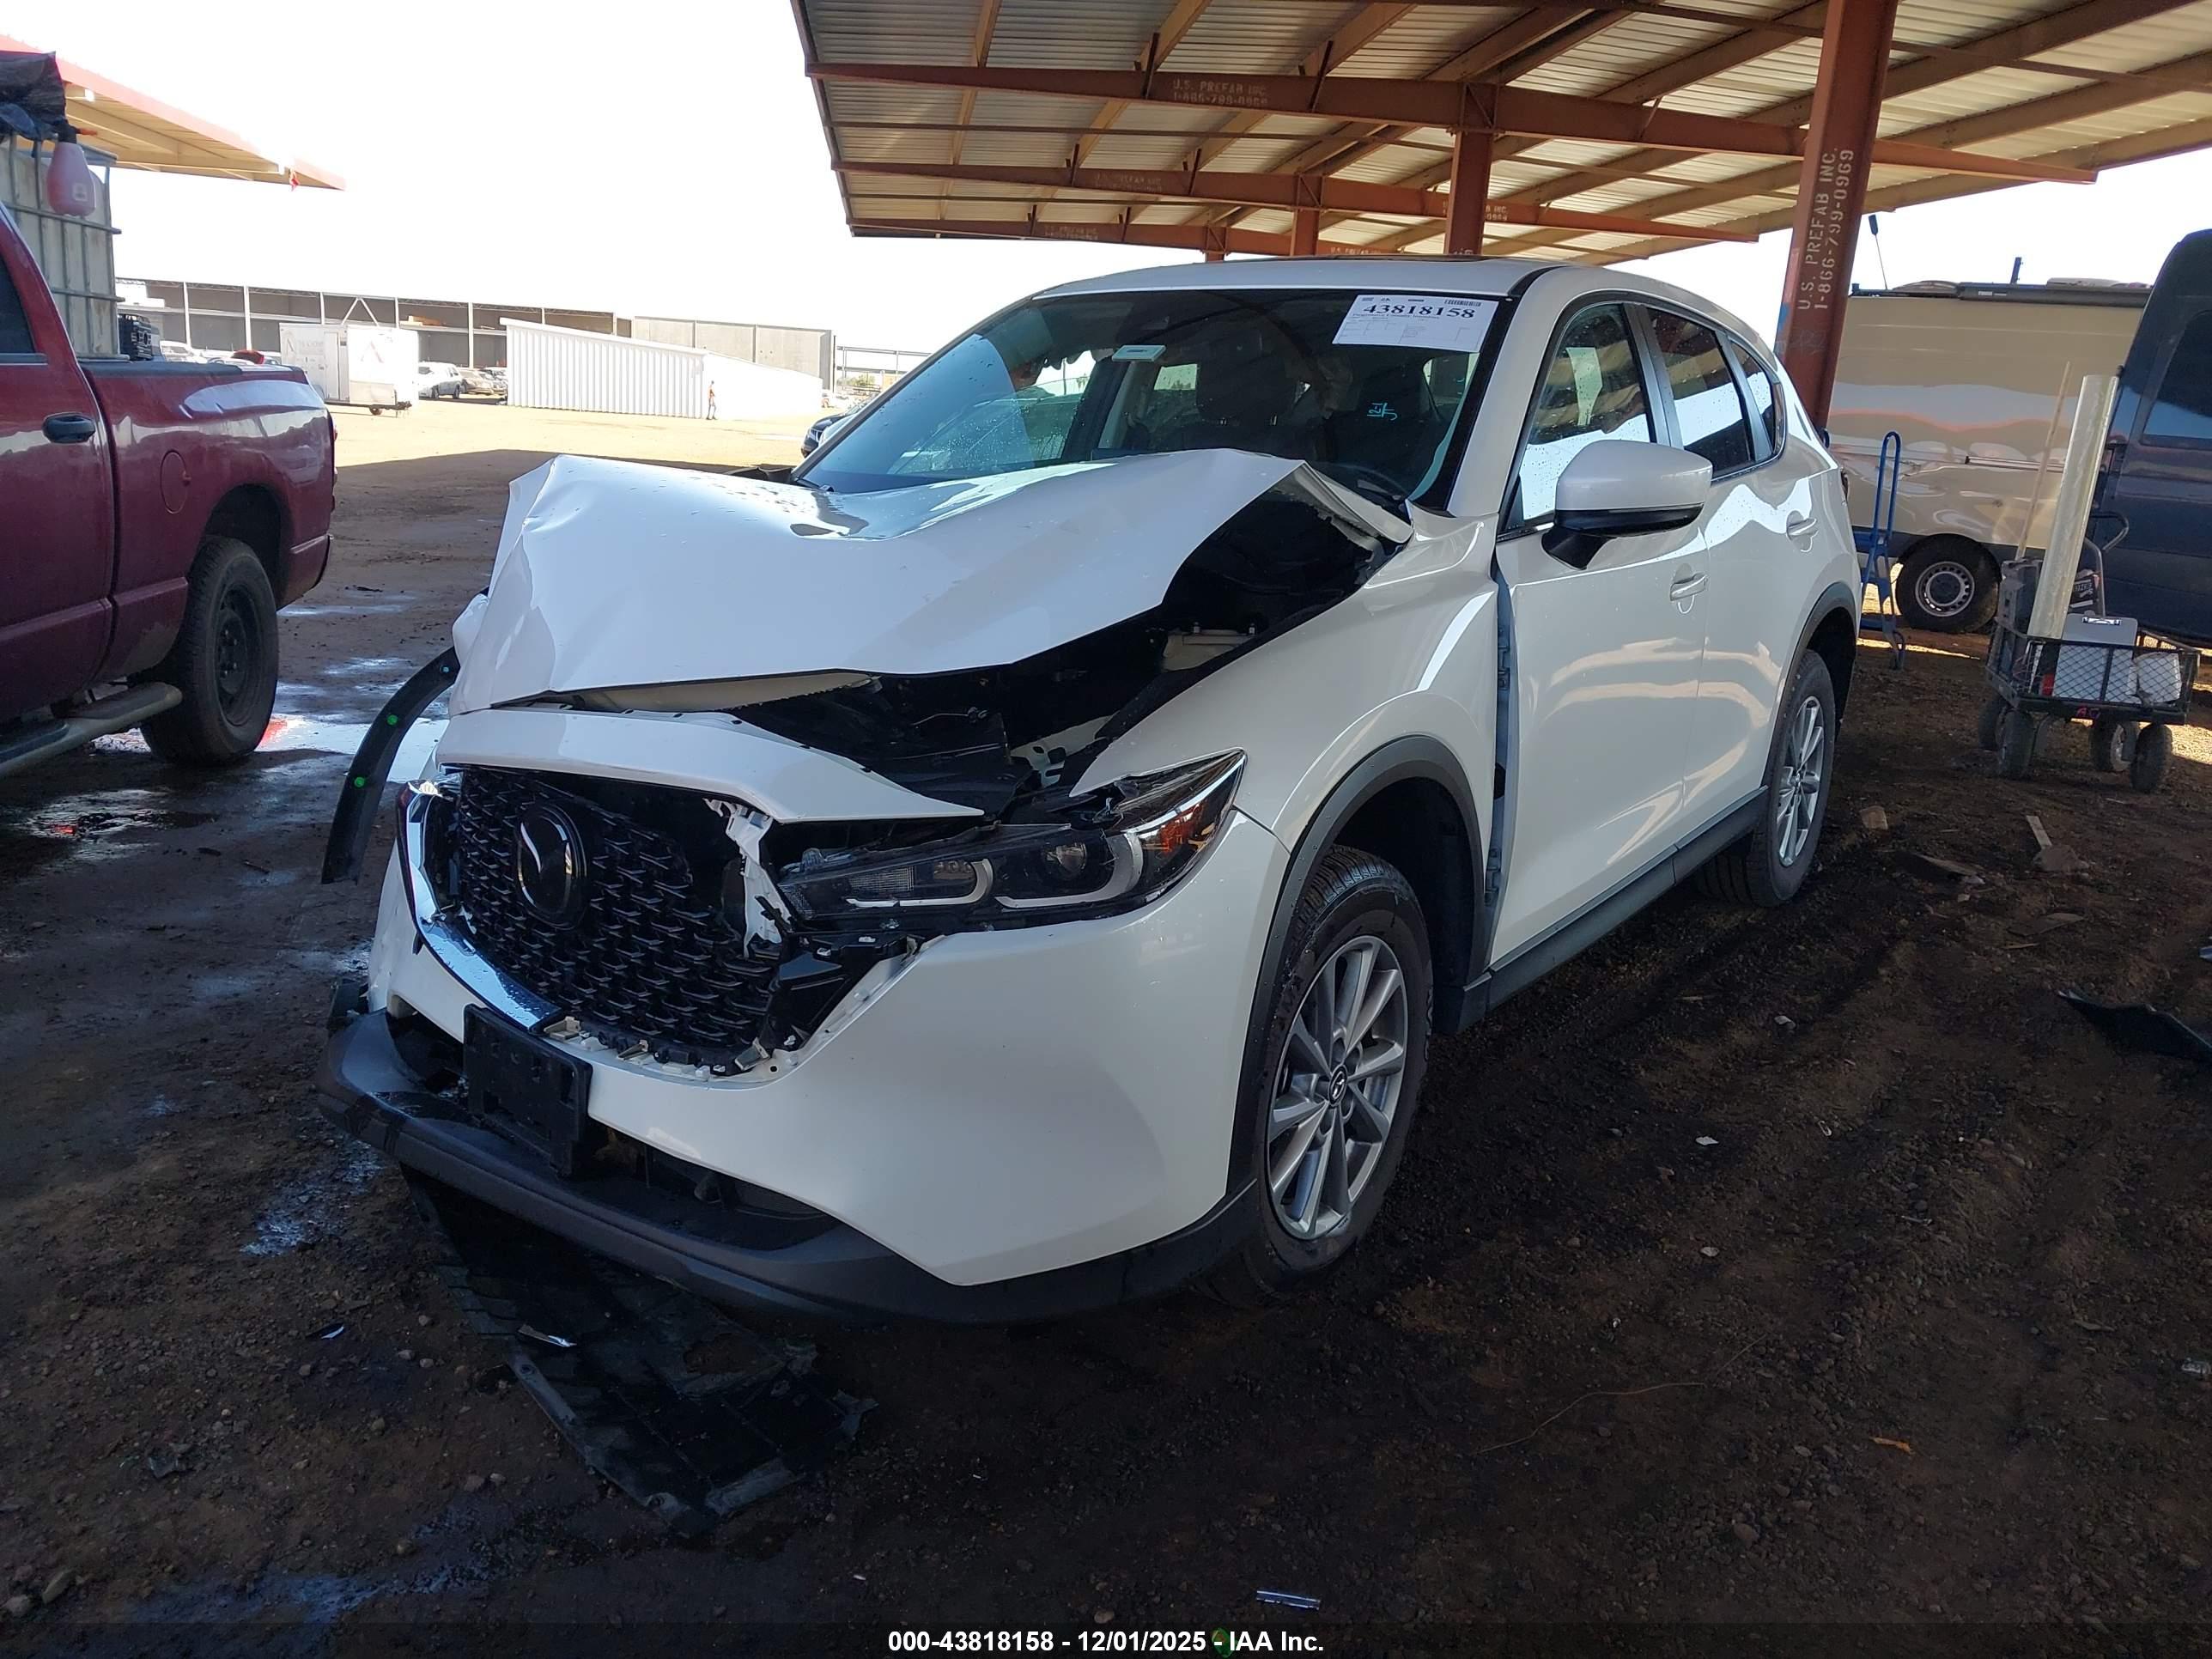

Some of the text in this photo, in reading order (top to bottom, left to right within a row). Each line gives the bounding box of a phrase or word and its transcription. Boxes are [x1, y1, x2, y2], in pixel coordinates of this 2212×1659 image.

[1200, 81, 1243, 94] PREFAB
[1819, 148, 1838, 182] INC.
[1805, 193, 1829, 264] PREFAB
[1814, 149, 1854, 309] 1-866-799-0969
[1797, 276, 1816, 310] U.S.
[1363, 304, 1477, 319] 43818158
